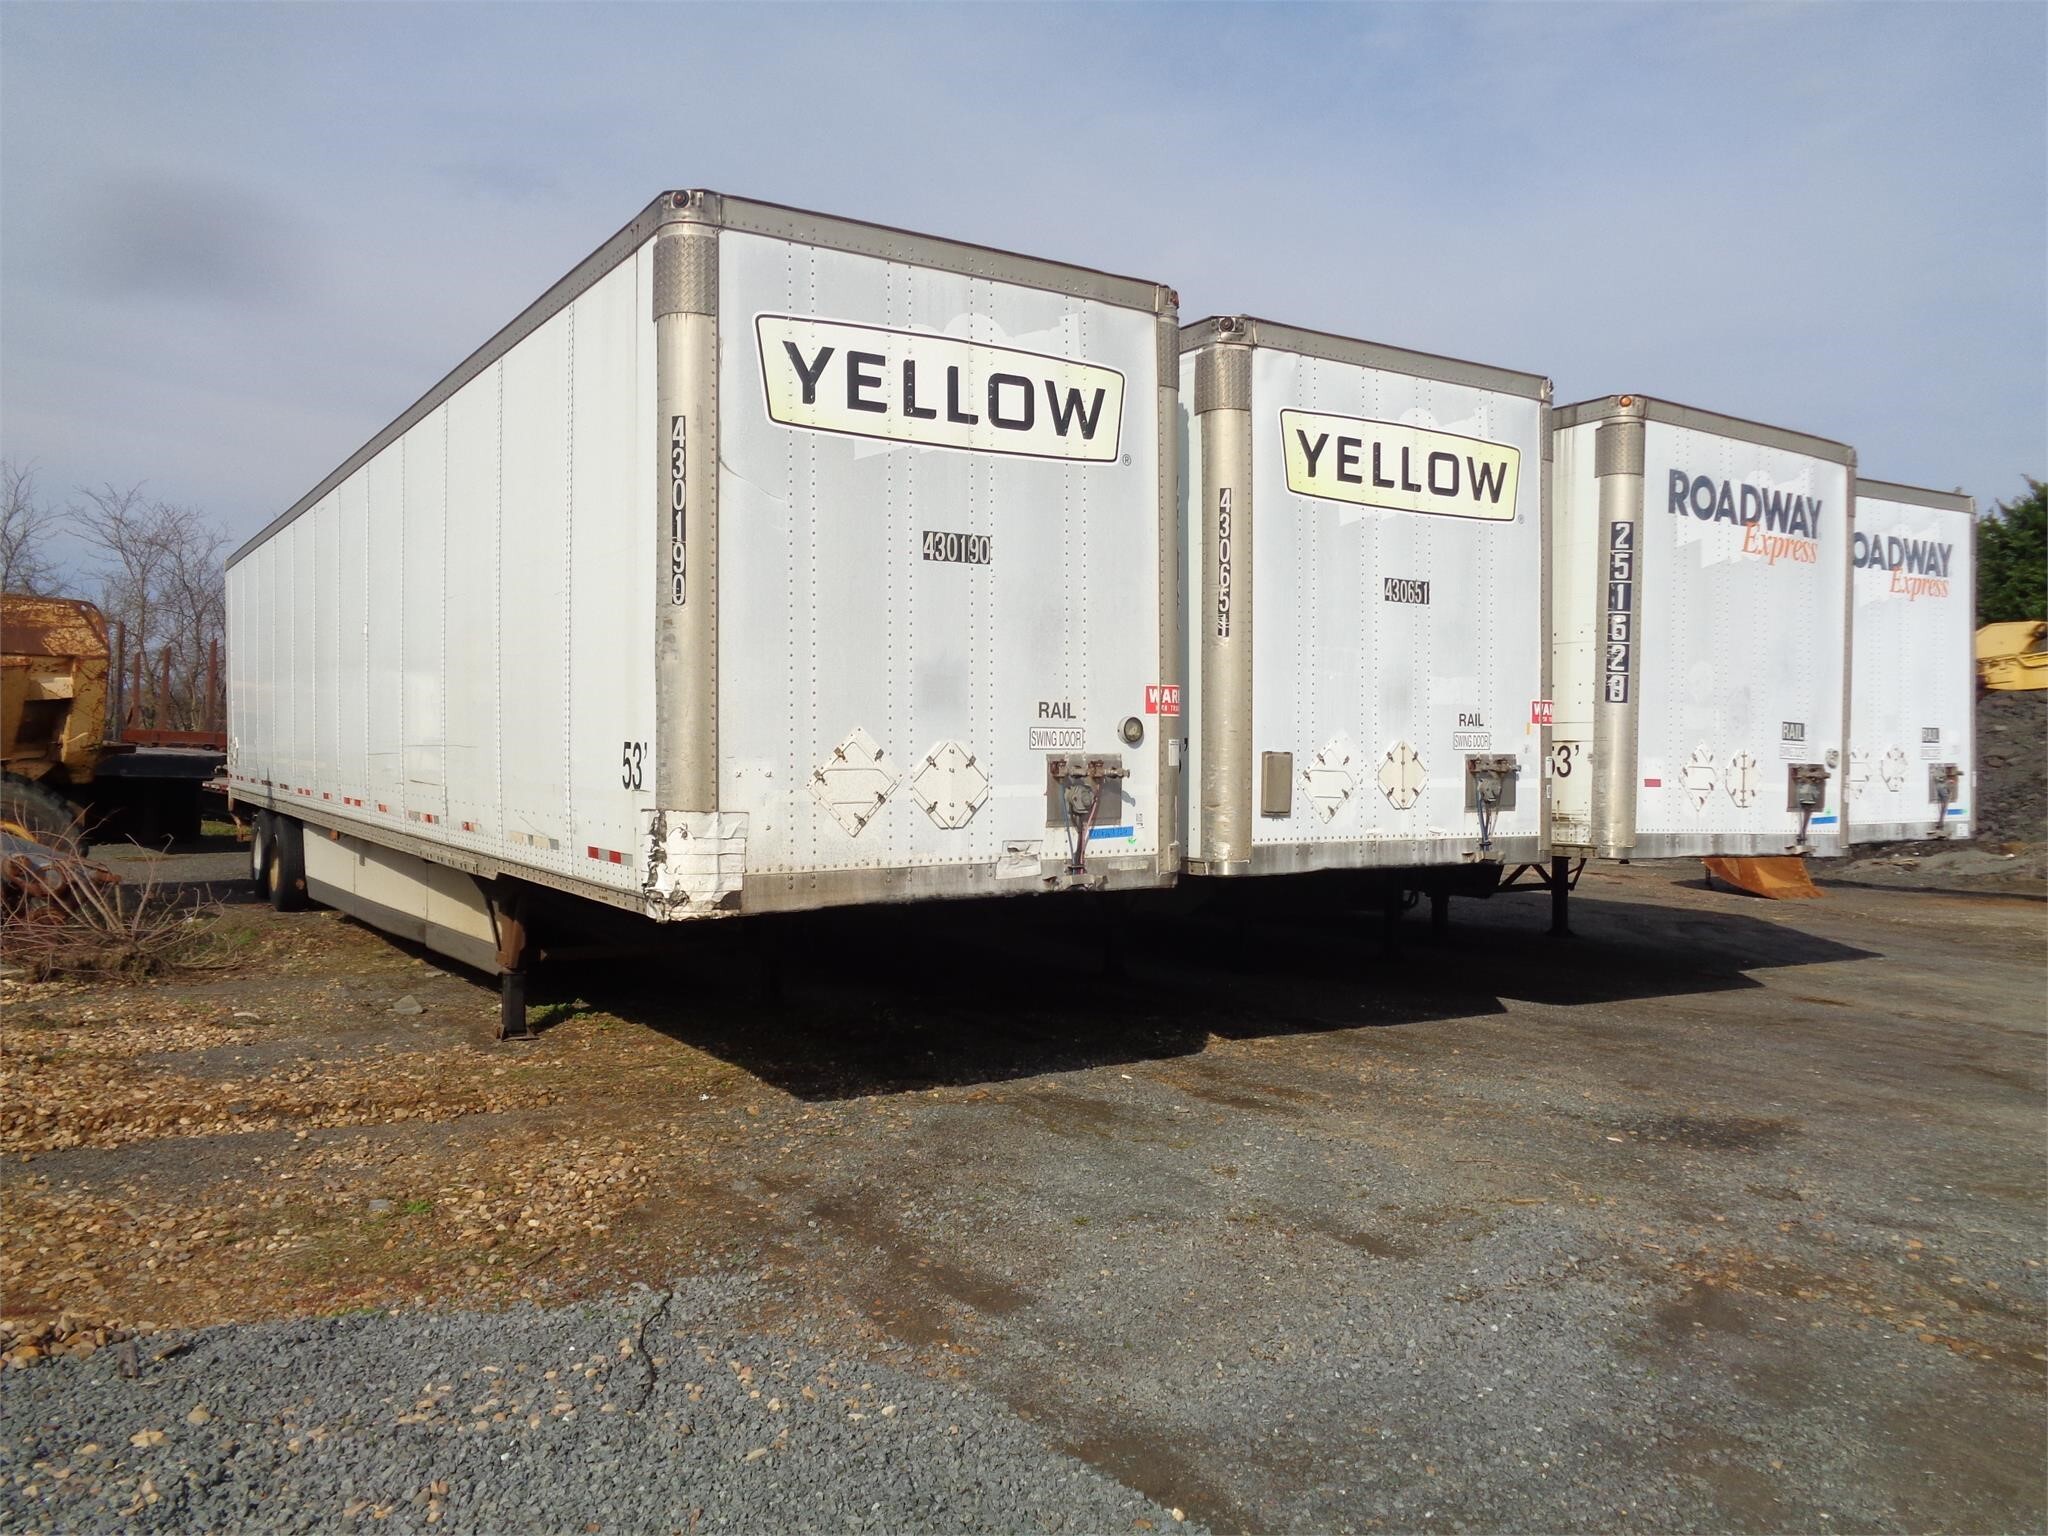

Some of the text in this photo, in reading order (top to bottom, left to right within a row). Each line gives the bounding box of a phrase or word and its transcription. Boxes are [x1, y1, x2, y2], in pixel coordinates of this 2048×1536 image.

[782, 340, 1107, 440] YELLOW
[1296, 429, 1508, 504] YELLOW
[672, 416, 686, 605] 430190
[1668, 468, 1823, 540] ROADWAY
[923, 531, 991, 564] 430190
[1741, 521, 1819, 566] Express
[1853, 531, 1953, 577] OADWAY
[1385, 578, 1430, 604] 430651
[1889, 566, 1950, 602] Express
[1038, 701, 1077, 719] RAIL
[1148, 688, 1179, 704] WAR
[1458, 713, 1485, 728] RAIL
[1782, 722, 1804, 740] RAIL
[1031, 730, 1057, 747] SWING
